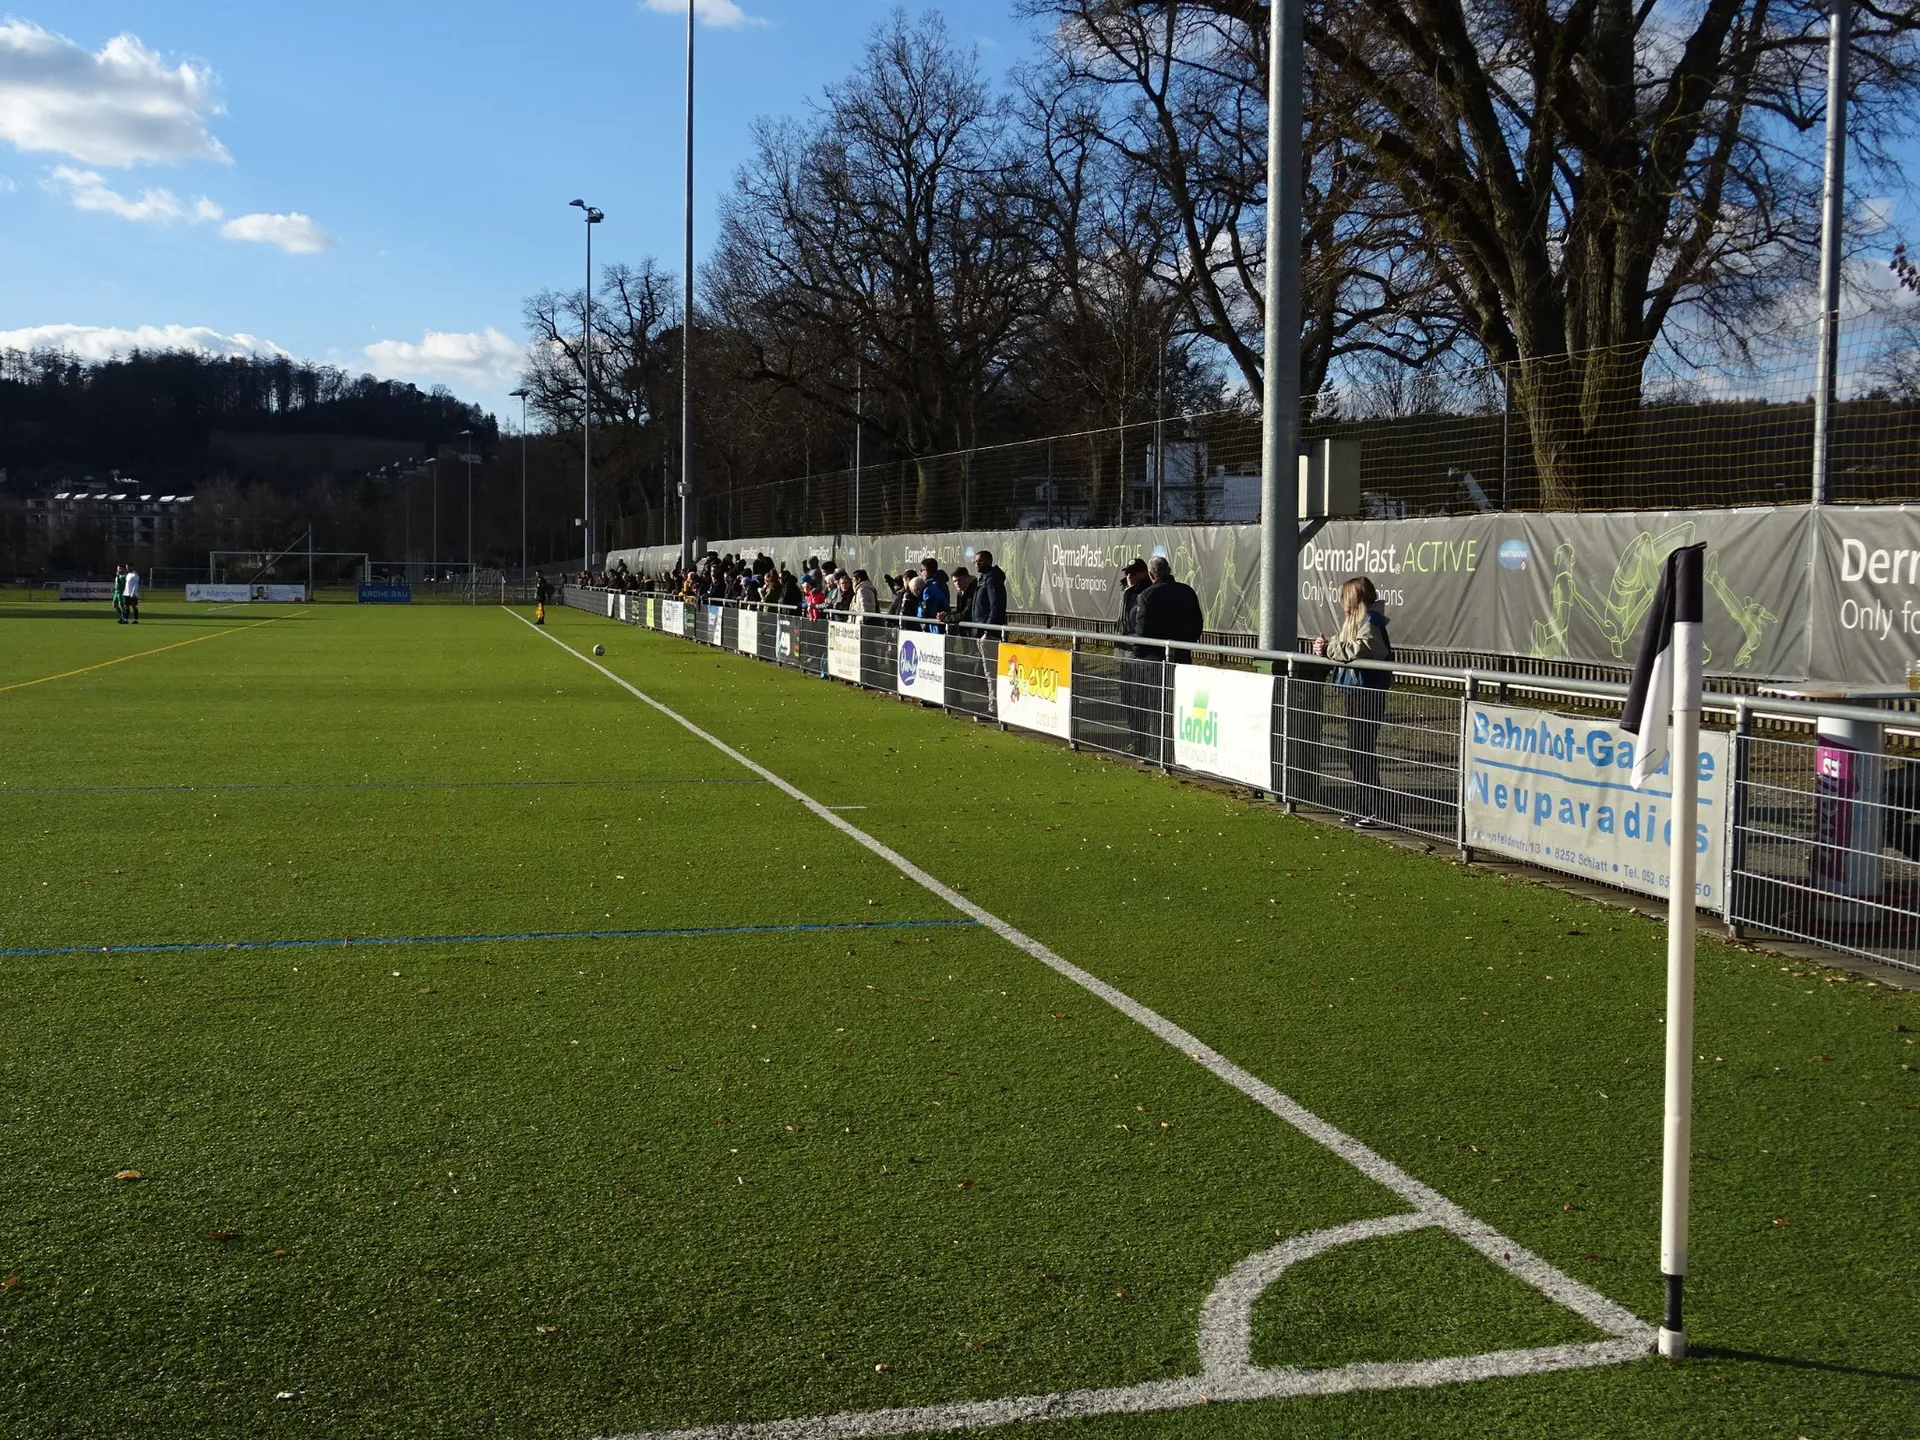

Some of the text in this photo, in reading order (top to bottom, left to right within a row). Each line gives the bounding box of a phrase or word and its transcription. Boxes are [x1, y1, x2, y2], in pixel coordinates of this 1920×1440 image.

[1402, 540, 1477, 573] ACTIVE
[1074, 574, 1107, 595] Champions
[1302, 580, 1325, 607] Only
[1840, 599, 1893, 640] Only
[1529, 842, 1541, 855] 13
[1554, 848, 1576, 863] 8252
[1578, 854, 1608, 873] Schlatt
[1623, 864, 1640, 880] Tel.
[1642, 869, 1656, 885] 052
